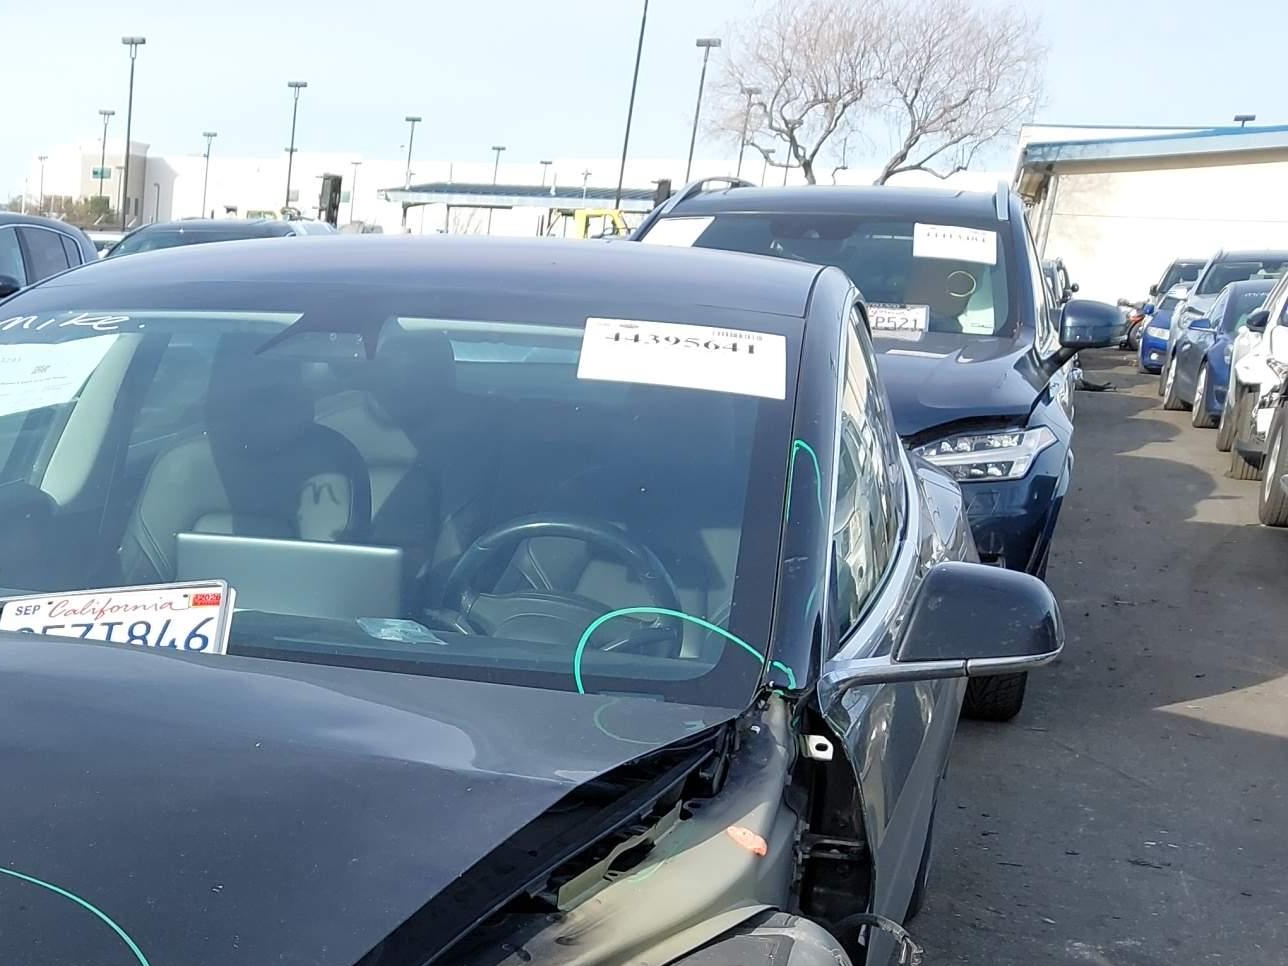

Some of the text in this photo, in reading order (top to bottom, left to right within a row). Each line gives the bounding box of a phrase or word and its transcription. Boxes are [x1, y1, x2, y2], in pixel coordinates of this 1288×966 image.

[605, 332, 755, 354] 44395641
[15, 604, 41, 617] SEP
[48, 597, 186, 621] California
